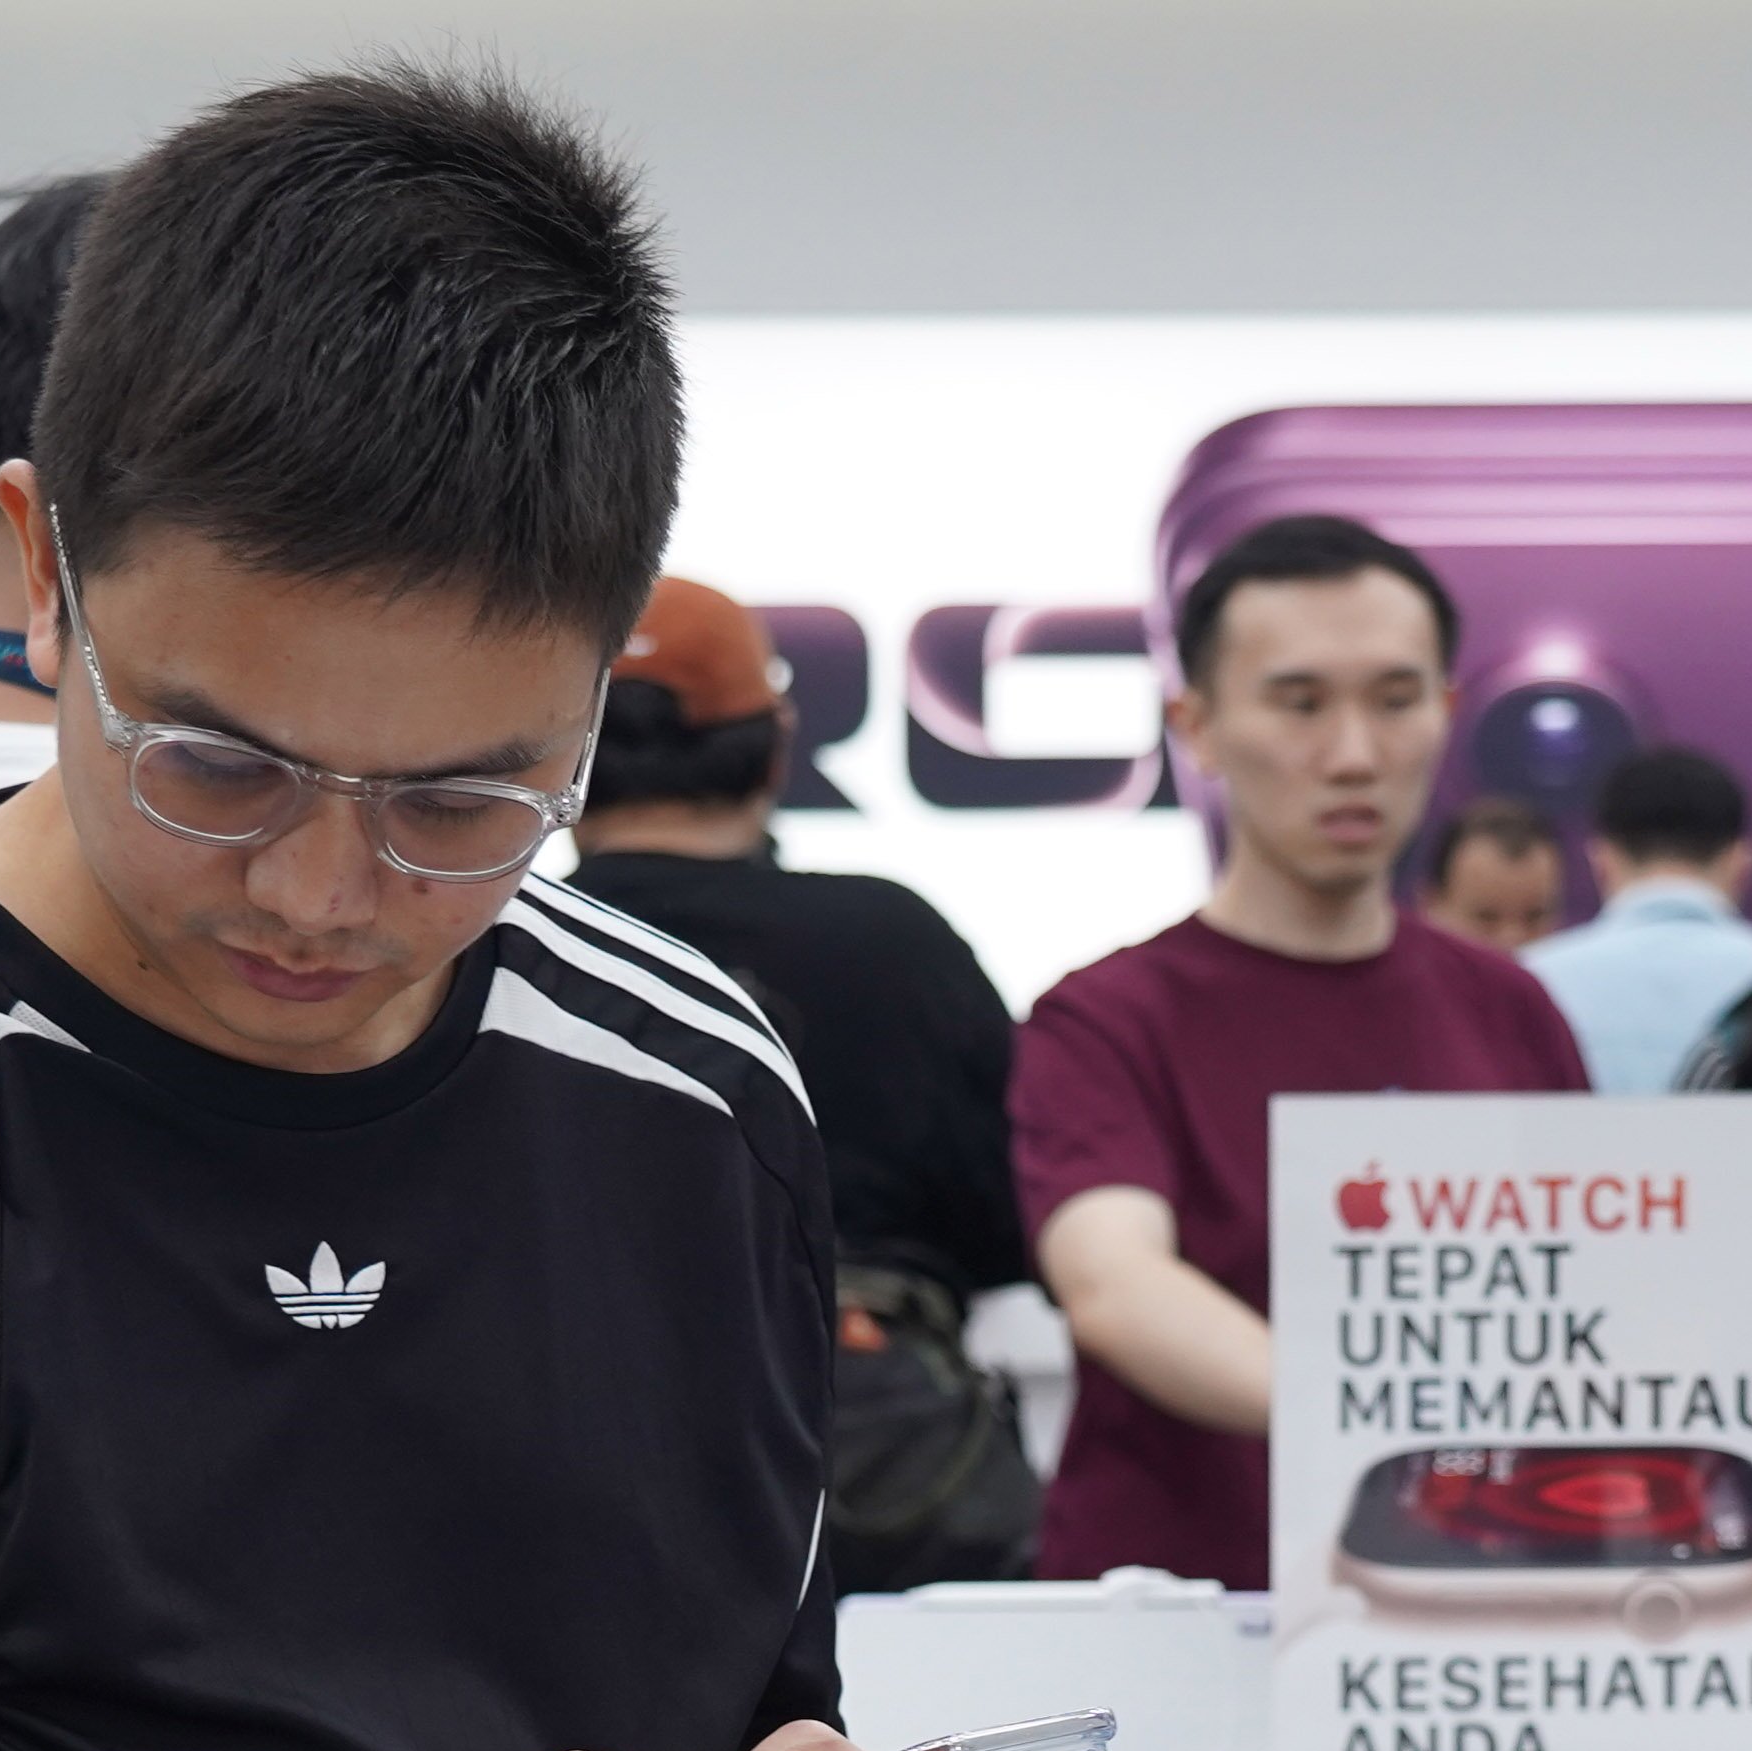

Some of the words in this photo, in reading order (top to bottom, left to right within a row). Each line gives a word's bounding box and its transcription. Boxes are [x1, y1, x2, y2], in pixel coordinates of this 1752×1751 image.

[1409, 1176, 1687, 1234] WATCH
[1336, 1244, 1574, 1301] TEPAT
[1338, 1310, 1608, 1367] UNTUK
